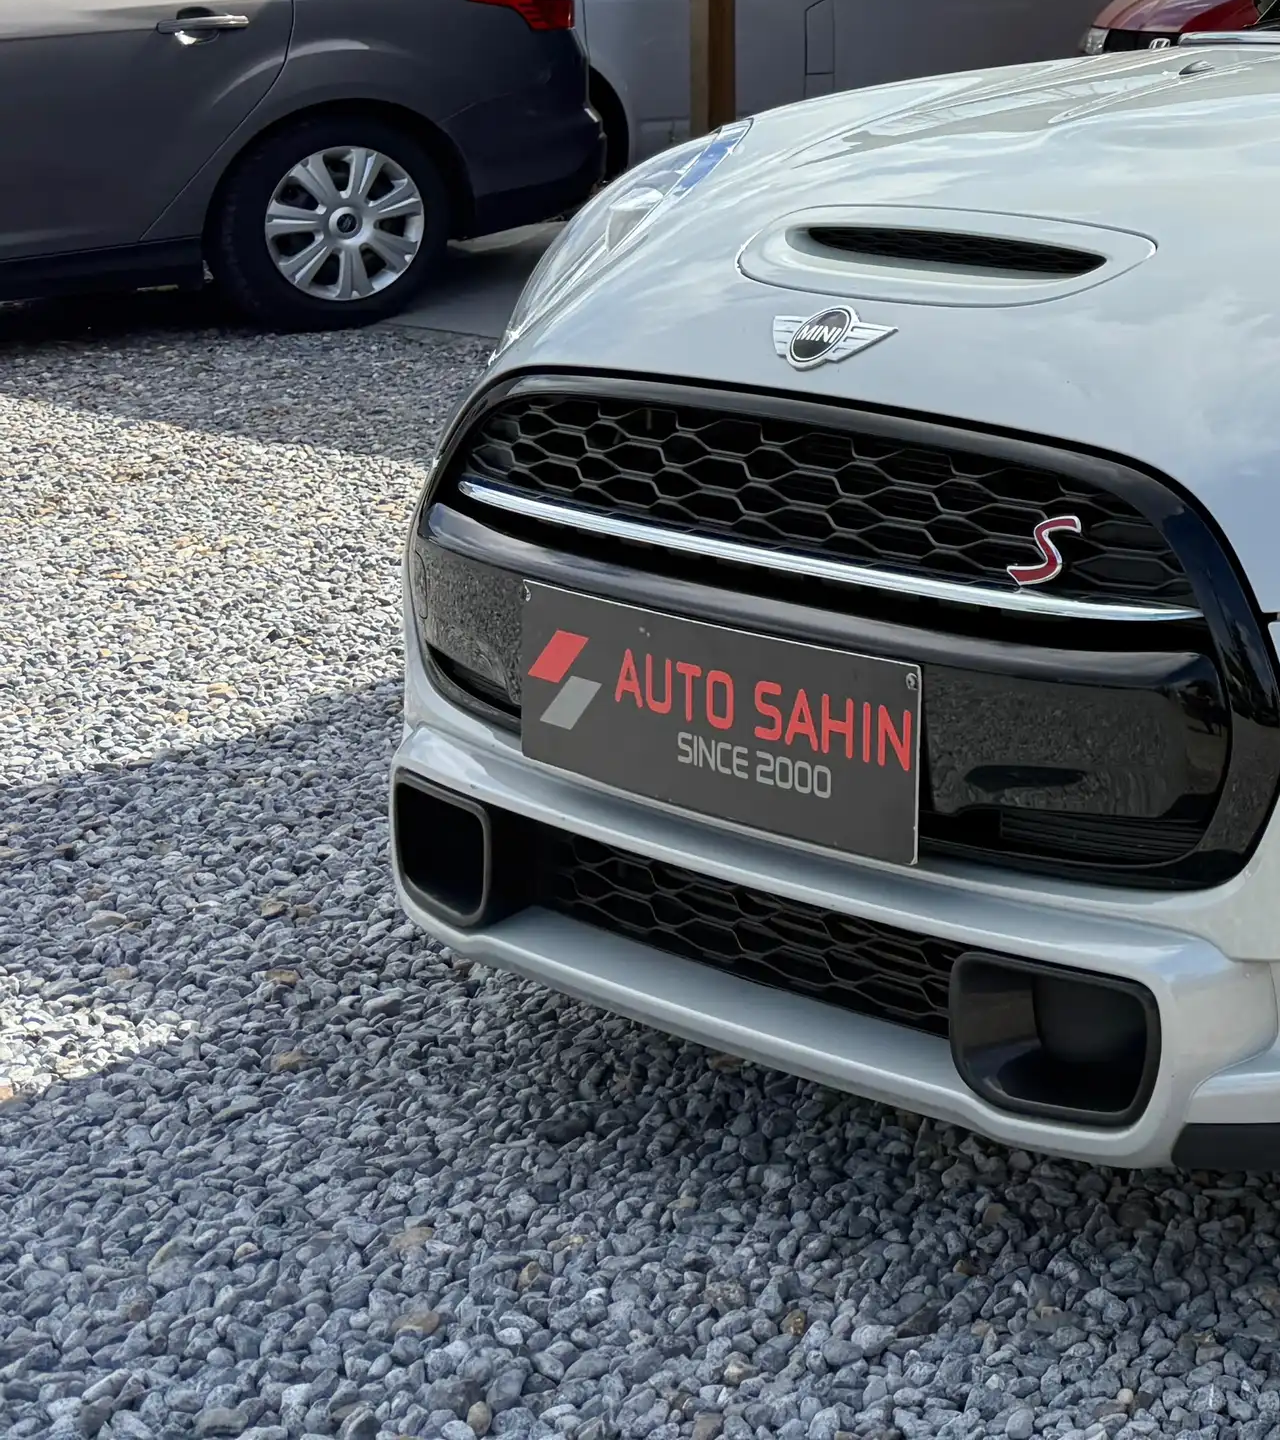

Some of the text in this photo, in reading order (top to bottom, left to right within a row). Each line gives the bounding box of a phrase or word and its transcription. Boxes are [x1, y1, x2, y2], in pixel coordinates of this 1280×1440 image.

[797, 324, 843, 344] MINI
[1006, 515, 1082, 587] S
[614, 648, 912, 772] AUTO SAHIN
[676, 732, 832, 799] SINCE 2000
